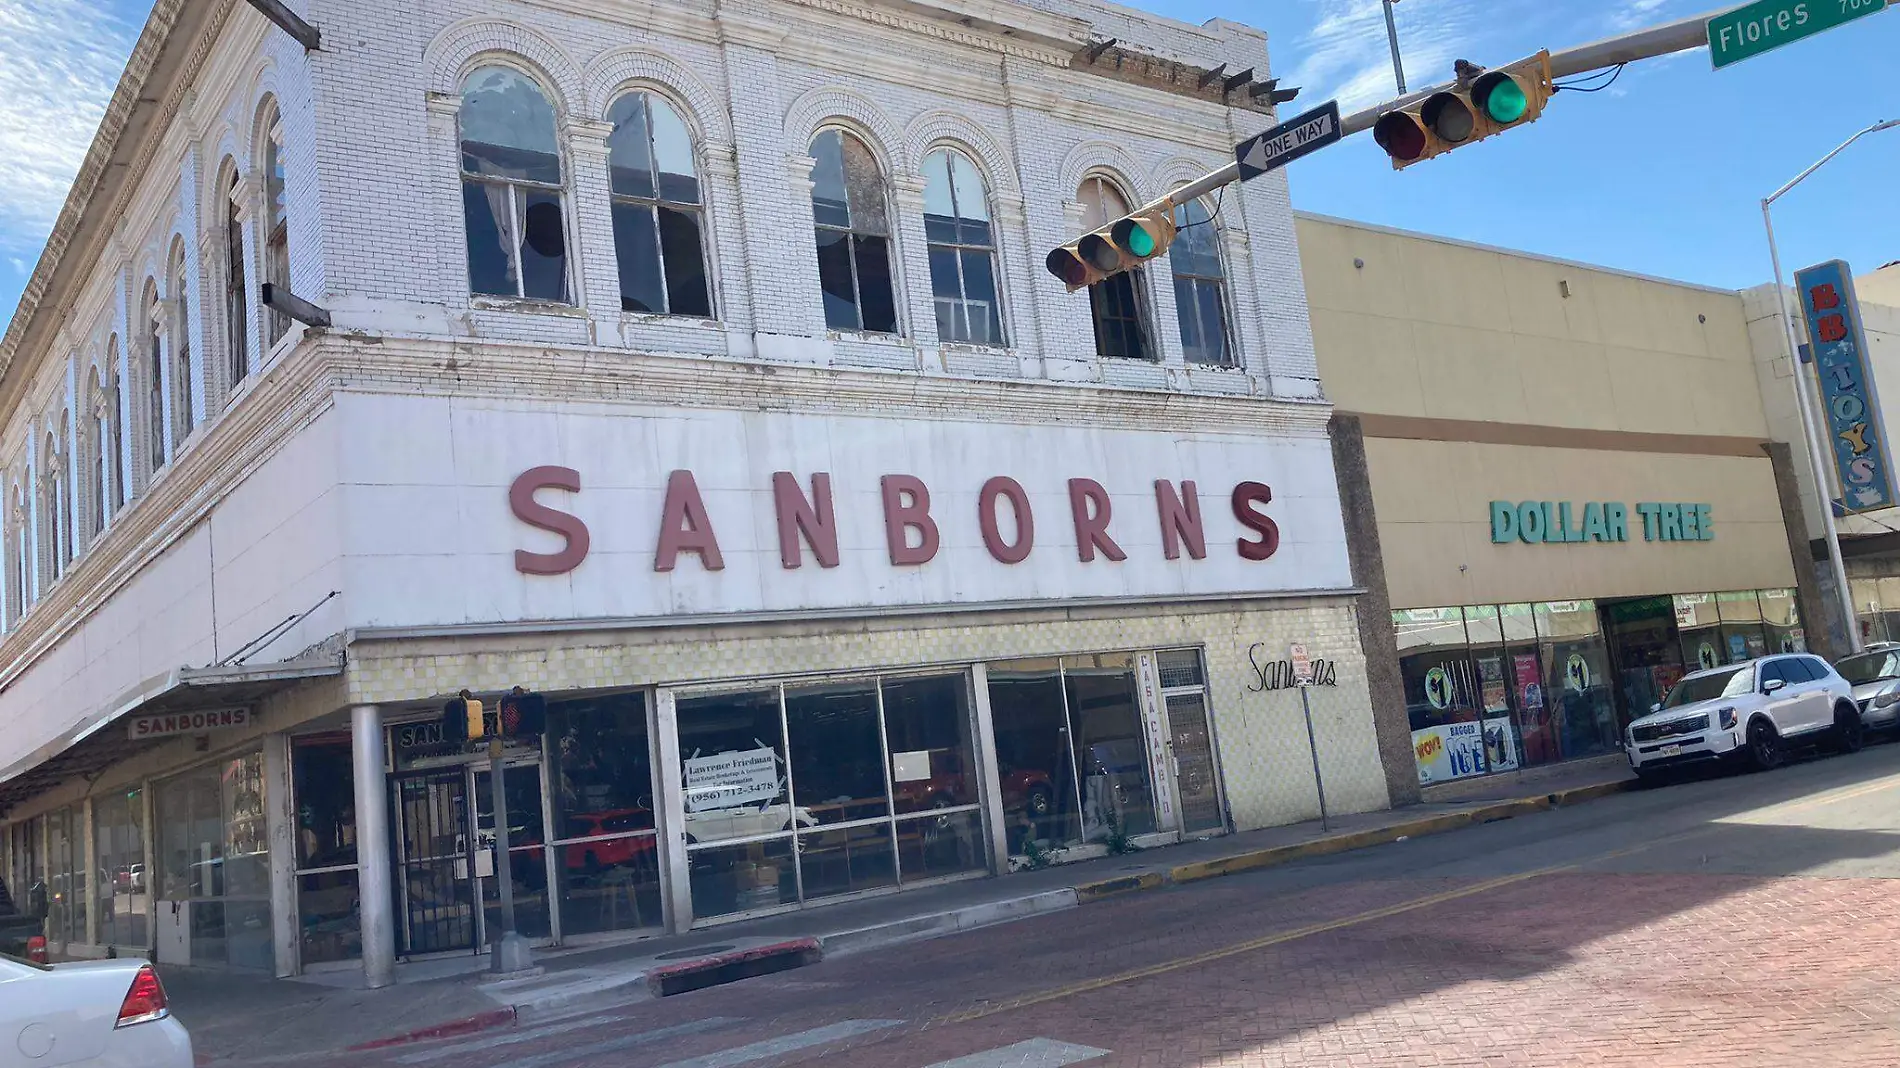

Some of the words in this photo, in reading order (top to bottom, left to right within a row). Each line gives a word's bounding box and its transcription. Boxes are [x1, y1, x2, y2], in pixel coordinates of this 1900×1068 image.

[1719, 3, 1809, 52] Flores
[1264, 134, 1292, 158] ONE
[1296, 118, 1324, 144] WAY
[508, 464, 1281, 576] SANBORNS
[1489, 500, 1629, 544] DOLLAR
[1635, 502, 1715, 542] TREE
[136, 709, 246, 735] SANBORNS
[1450, 725, 1476, 736] BAGGED
[689, 762, 731, 775] Lawrence
[732, 756, 772, 768] Friedman
[1446, 737, 1485, 776] ICE
[691, 792, 720, 803] (956)
[724, 782, 773, 796] 712-3478
